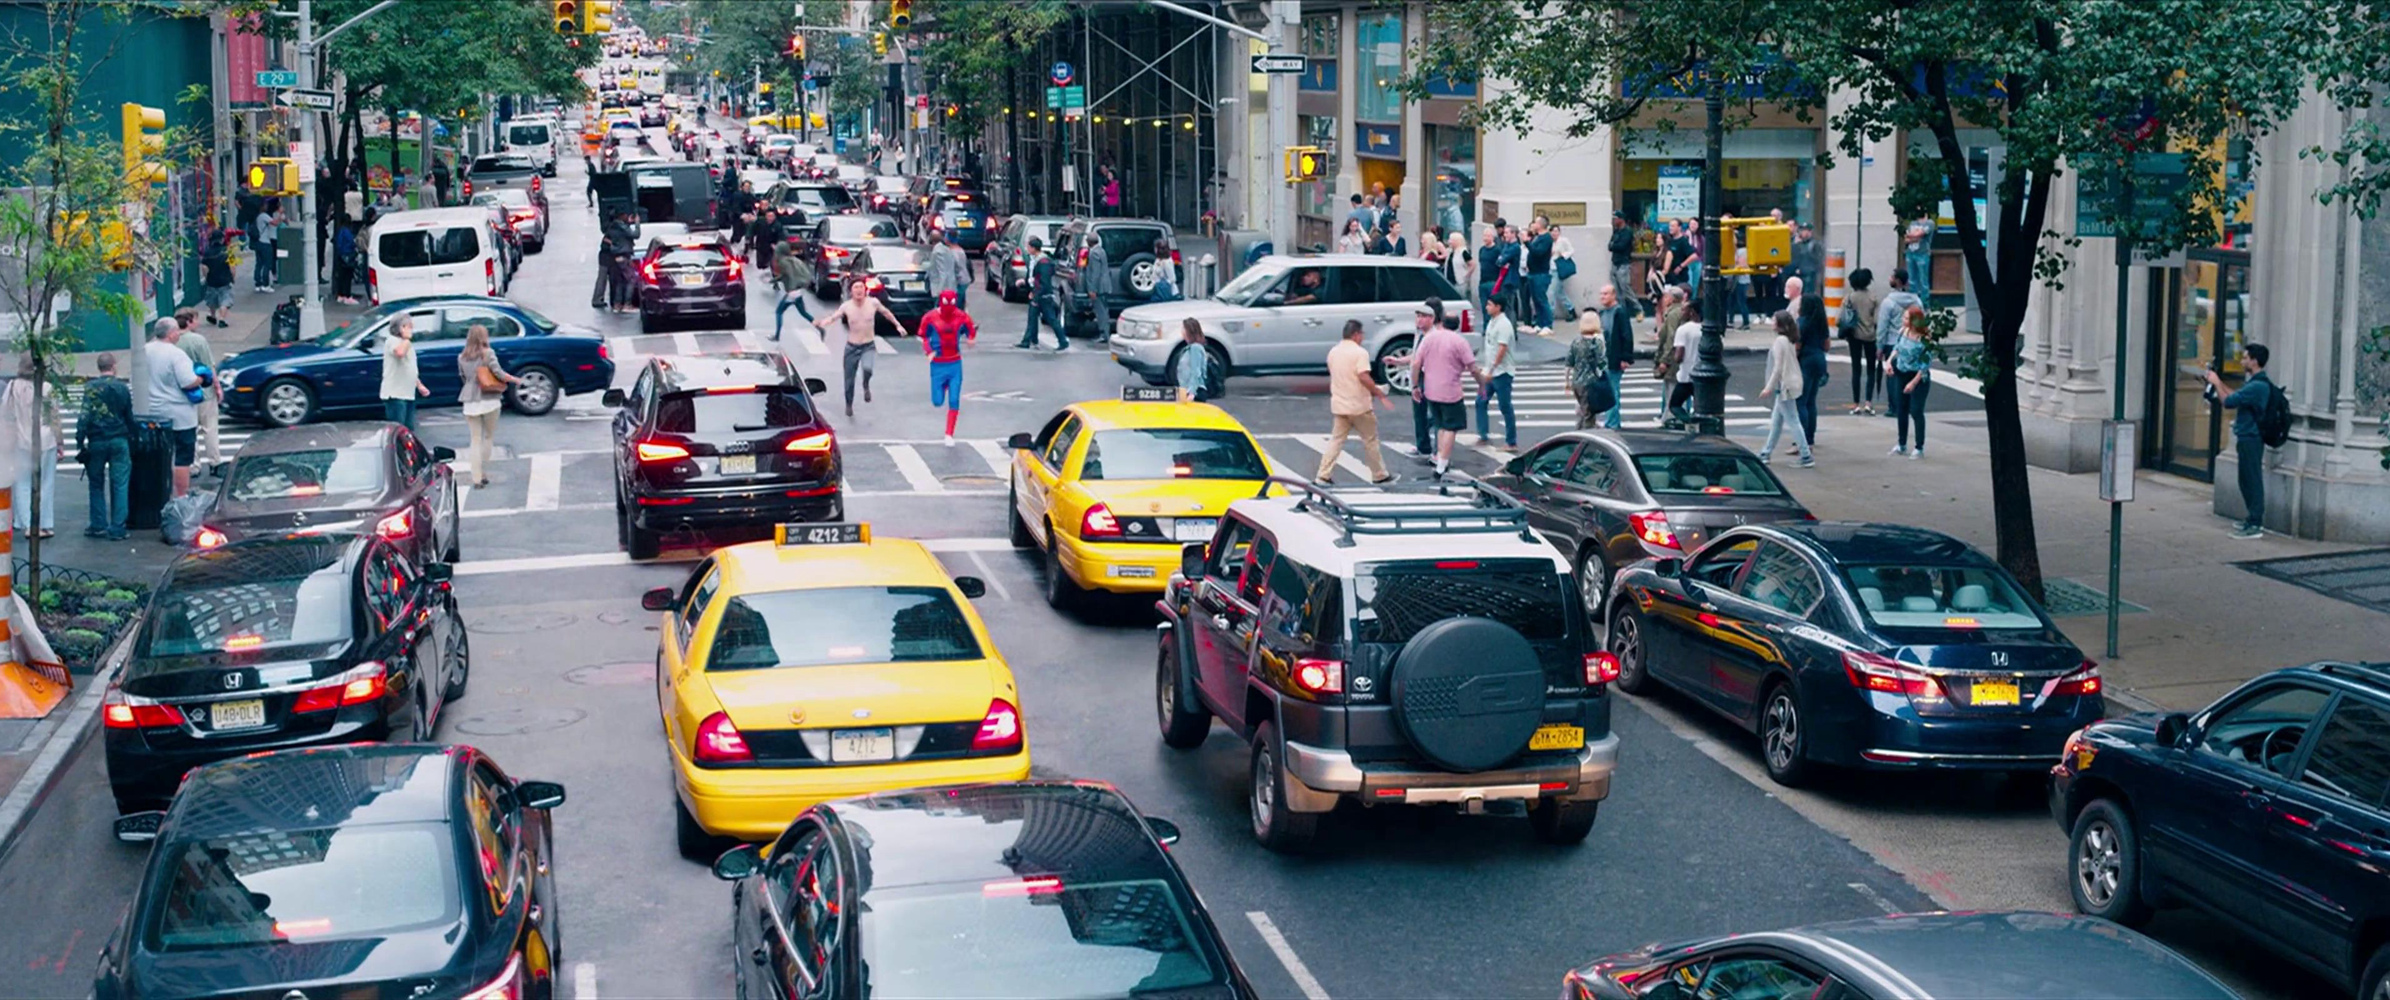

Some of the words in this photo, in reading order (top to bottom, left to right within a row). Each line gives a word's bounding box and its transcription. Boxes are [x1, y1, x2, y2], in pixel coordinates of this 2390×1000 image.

[260, 74, 266, 85] E
[271, 73, 284, 85] 29
[1660, 183, 1673, 196] 12
[807, 527, 840, 543] 4Z12
